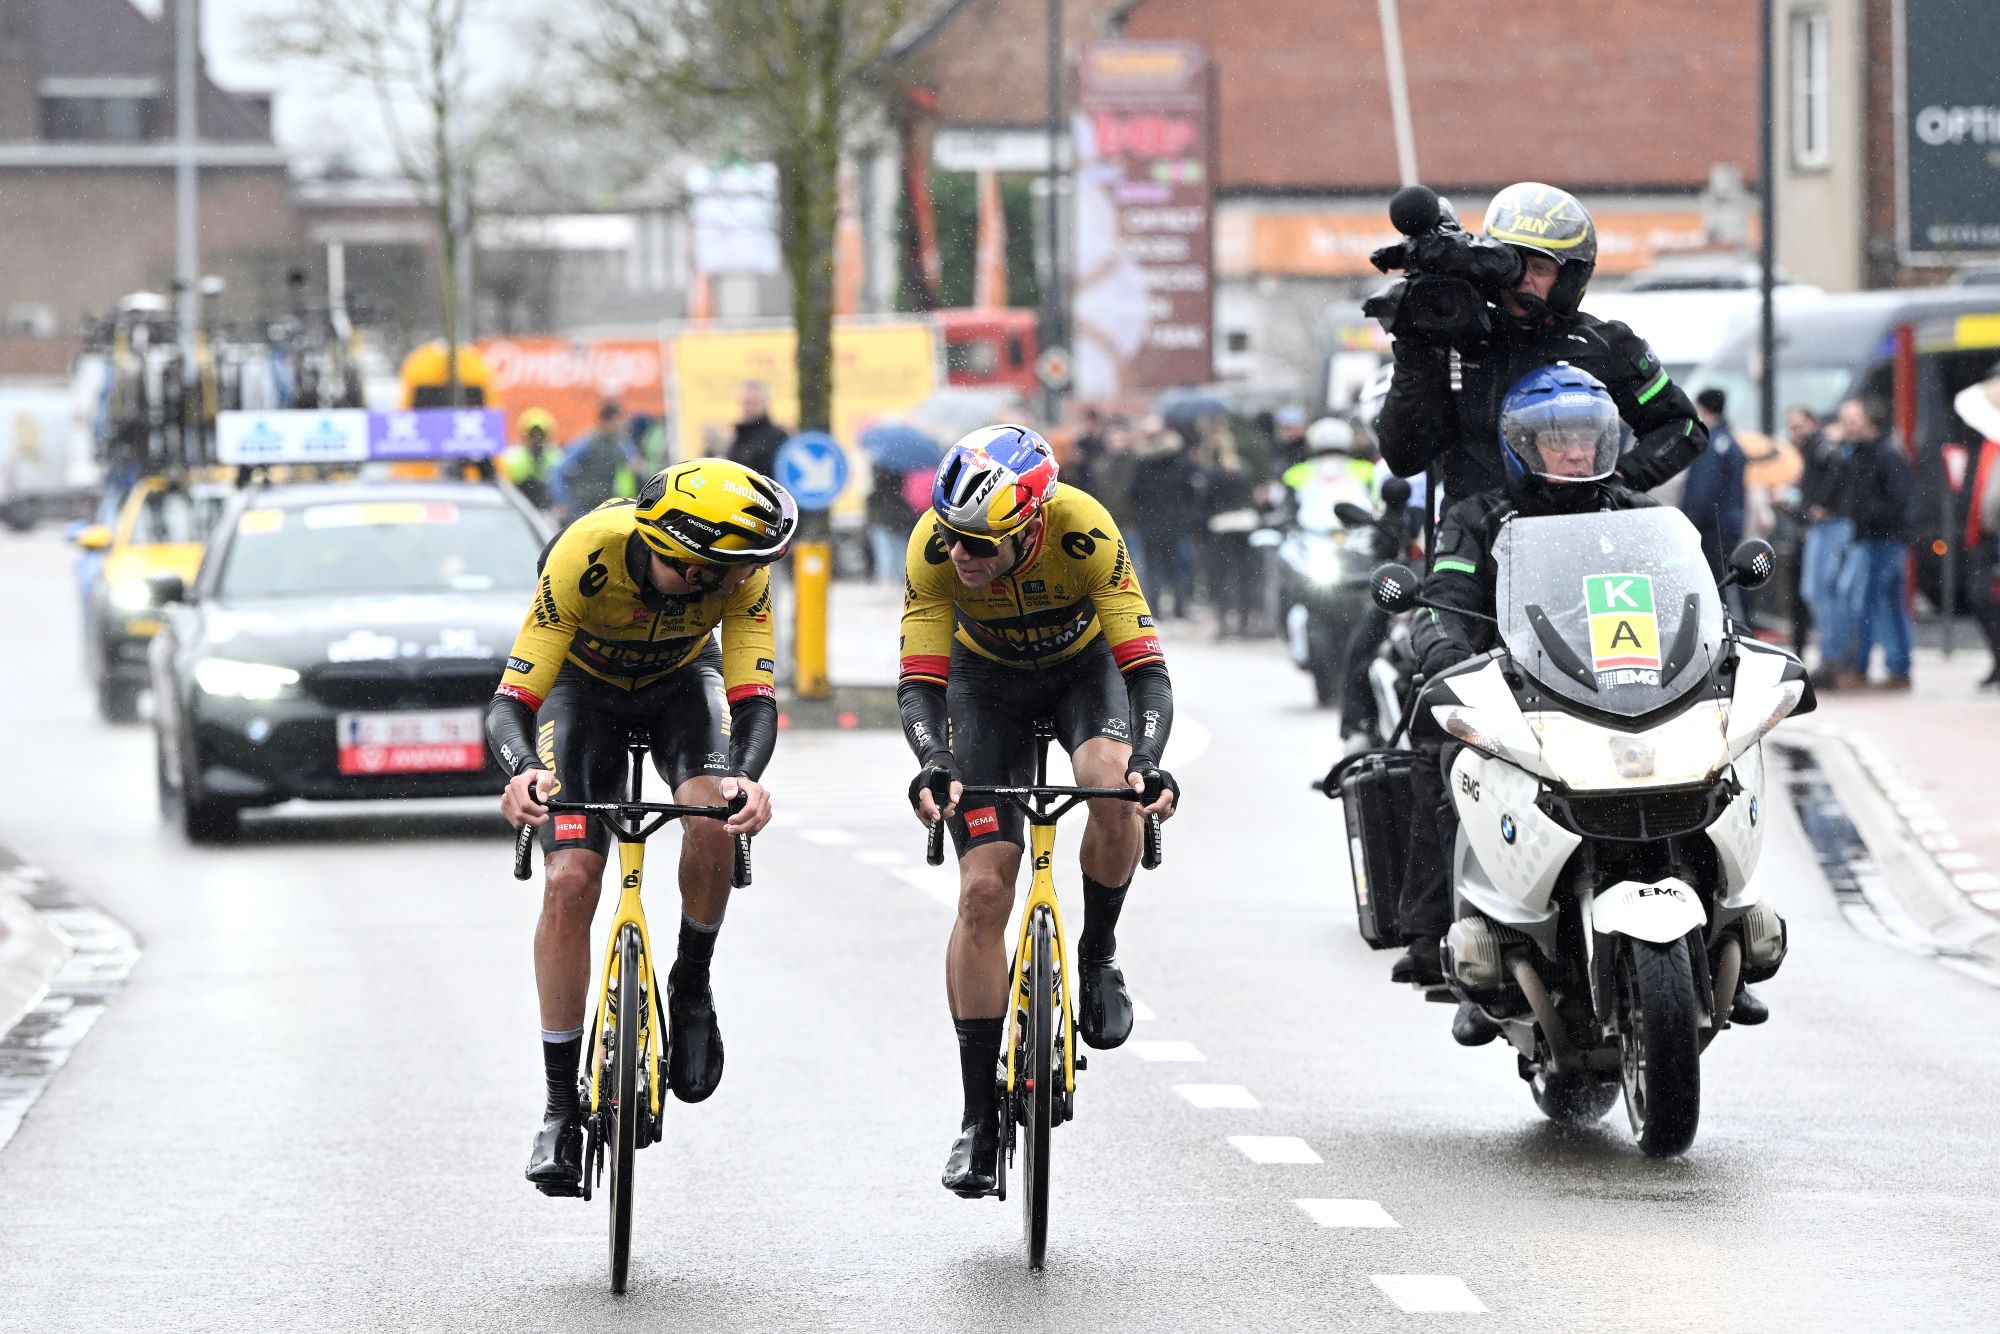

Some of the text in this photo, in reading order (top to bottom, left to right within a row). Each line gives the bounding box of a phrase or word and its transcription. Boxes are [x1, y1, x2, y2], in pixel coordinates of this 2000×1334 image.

[1508, 213, 1551, 235] JAN
[722, 479, 774, 513] CHRISTOPHE
[975, 466, 1005, 506] LAZER
[730, 513, 756, 528] JUMBO
[665, 525, 702, 550] LAZER
[1109, 538, 1124, 588] JUMBO
[542, 574, 560, 624] JUMBO
[1603, 579, 1640, 609] K
[534, 594, 549, 627] VISMA
[1610, 620, 1643, 653] A
[1616, 669, 1660, 686] EMG
[1101, 727, 1129, 739] AGU
[1144, 716, 1157, 739] AGU
[703, 763, 730, 771] AGU
[1462, 772, 1480, 802] EMG
[556, 823, 583, 832] HEMA
[968, 815, 995, 829] HEMA
[1151, 811, 1161, 854] SRAM
[516, 823, 532, 866] SRAM
[739, 833, 752, 875] SRAM
[1638, 887, 1687, 903] EMG
